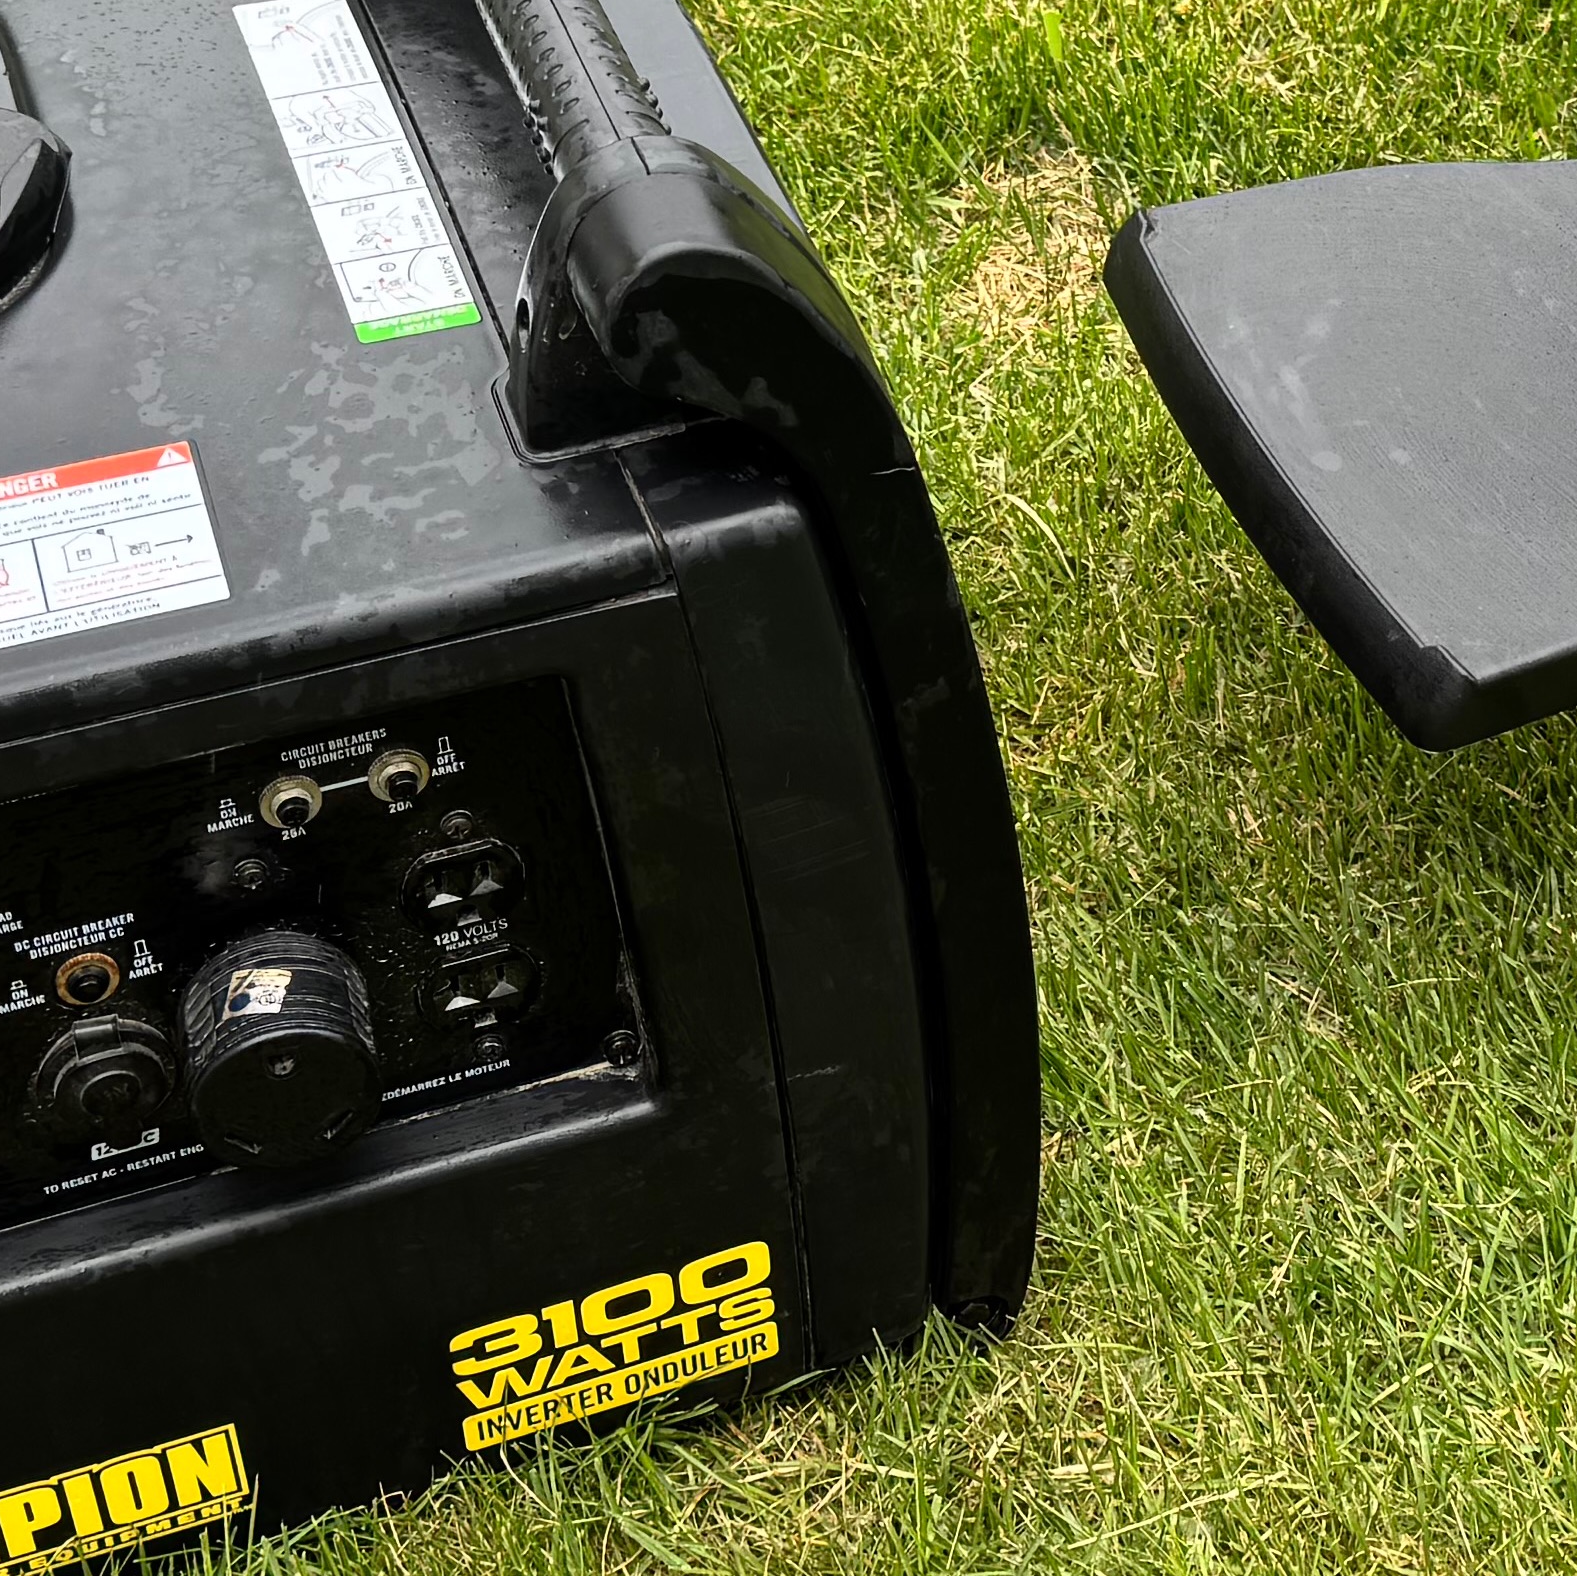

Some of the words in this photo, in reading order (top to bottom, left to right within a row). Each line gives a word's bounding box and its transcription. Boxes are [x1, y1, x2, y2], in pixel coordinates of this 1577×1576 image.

[280, 742, 325, 762] CIRCUIT
[328, 727, 387, 751] BREAKERS
[298, 743, 374, 770] DISJONCTEUR
[436, 752, 457, 766] OFF
[207, 813, 255, 834] MARCHE
[13, 940, 31, 953] DC
[33, 926, 79, 948] CIRCUIT
[82, 912, 135, 934] BREAKER
[29, 932, 107, 960] DISJONCTEUR
[109, 926, 125, 939] CC
[433, 930, 460, 946] 120
[463, 918, 508, 938] VOLTS
[133, 955, 154, 968] OFF
[11, 988, 29, 1001] ON
[449, 1071, 462, 1083] LE
[465, 1059, 511, 1078] MOTEUR
[43, 1184, 59, 1195] TO
[61, 1173, 99, 1190] RESET
[101, 1168, 117, 1179] AC
[127, 1151, 176, 1172] RESTART
[449, 1241, 772, 1376] 3100
[456, 1287, 776, 1410] WATTS
[477, 1381, 614, 1442] INVERTER
[624, 1331, 769, 1395] ONDULEUR
